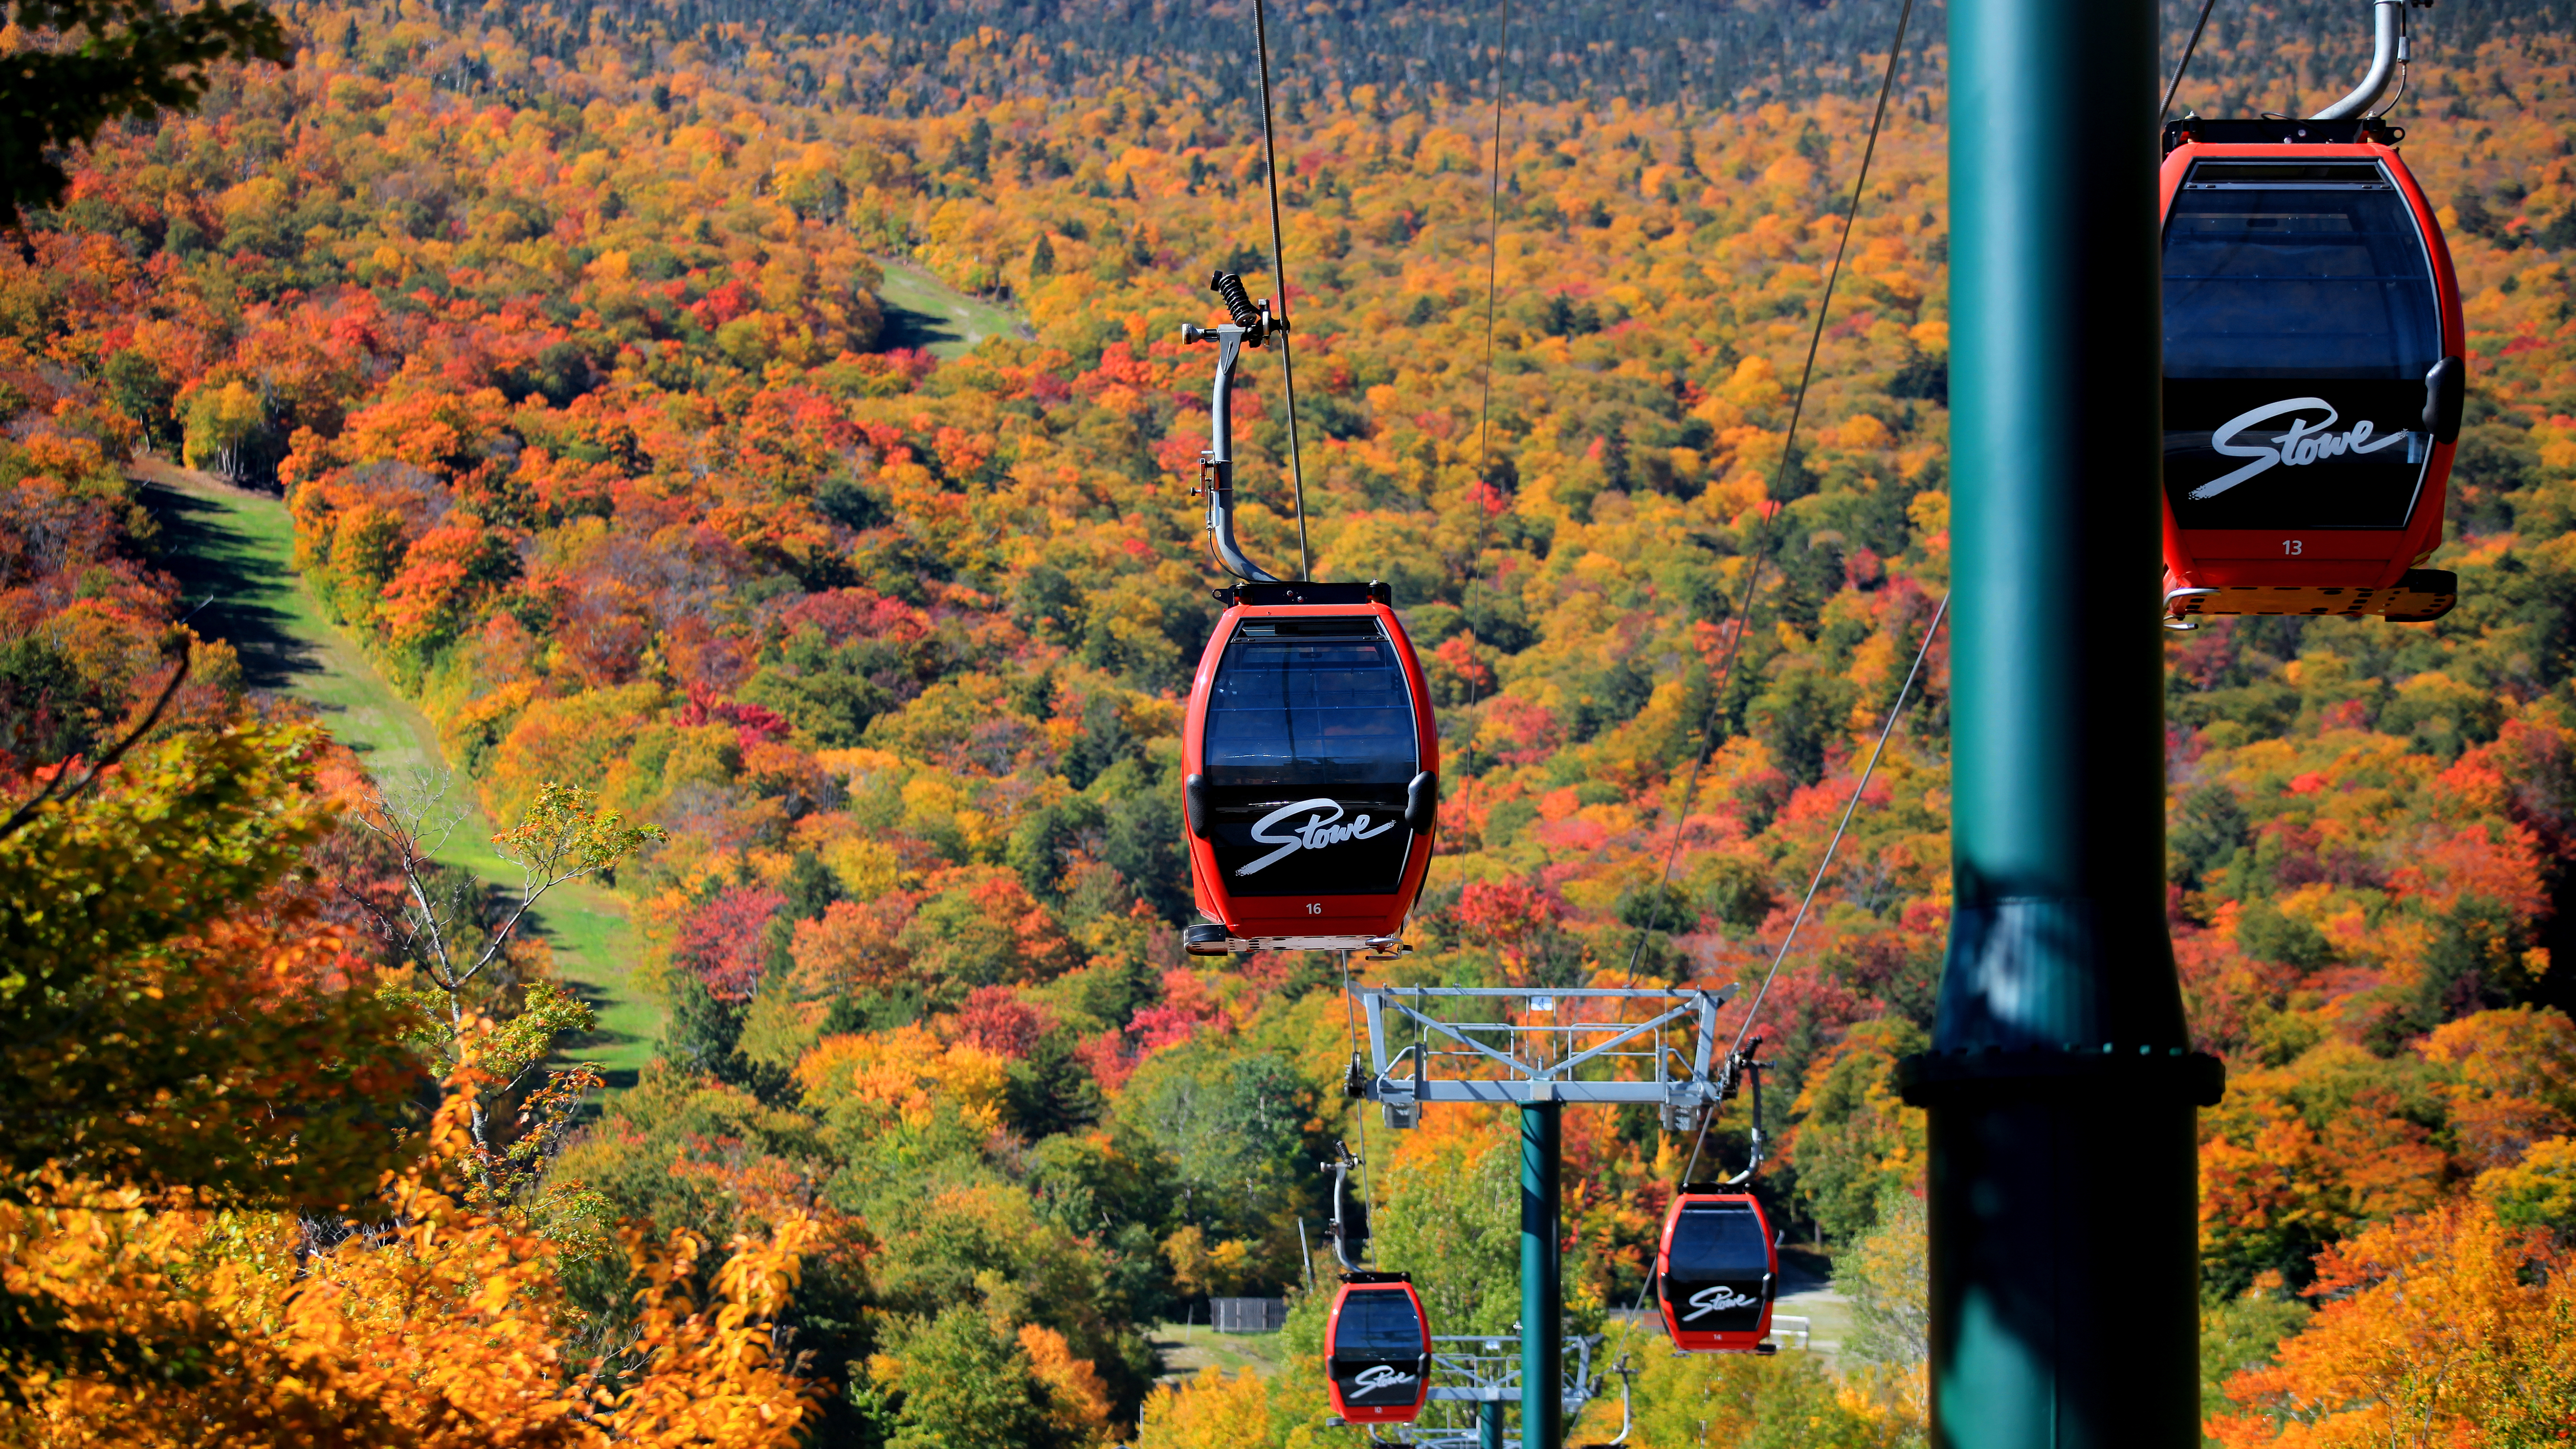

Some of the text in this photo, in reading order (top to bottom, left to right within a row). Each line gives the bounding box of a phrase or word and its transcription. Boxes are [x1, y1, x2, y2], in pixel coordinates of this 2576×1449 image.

[2188, 397, 2409, 500] Stowe
[2282, 540, 2302, 555] 13
[1236, 798, 1396, 876] Stowe
[1306, 903, 1322, 914] 16
[1682, 1286, 1757, 1321] Stowe
[1349, 1365, 1416, 1398] Stowe
